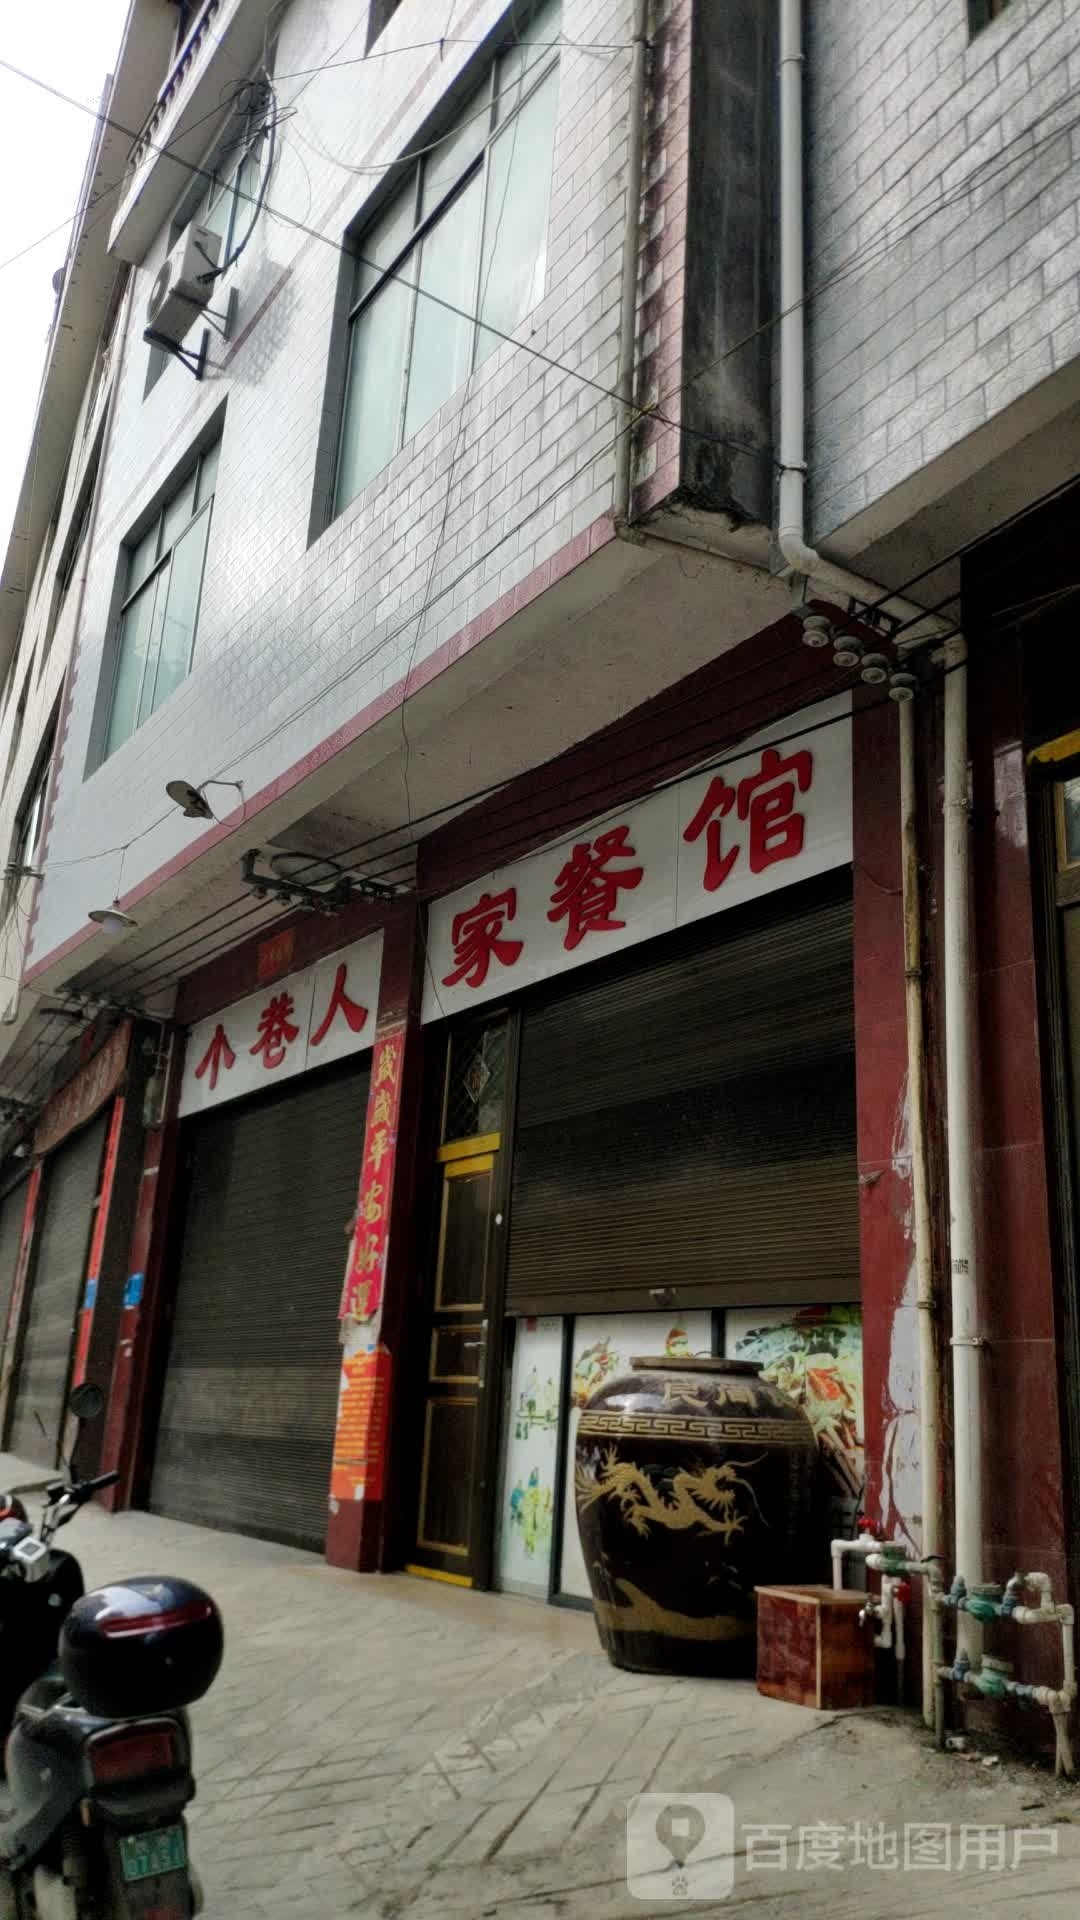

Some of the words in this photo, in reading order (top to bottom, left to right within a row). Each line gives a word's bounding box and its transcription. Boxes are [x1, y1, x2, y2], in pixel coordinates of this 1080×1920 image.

[441, 748, 813, 988] 家餐馆
[195, 961, 368, 1091] 小巷人
